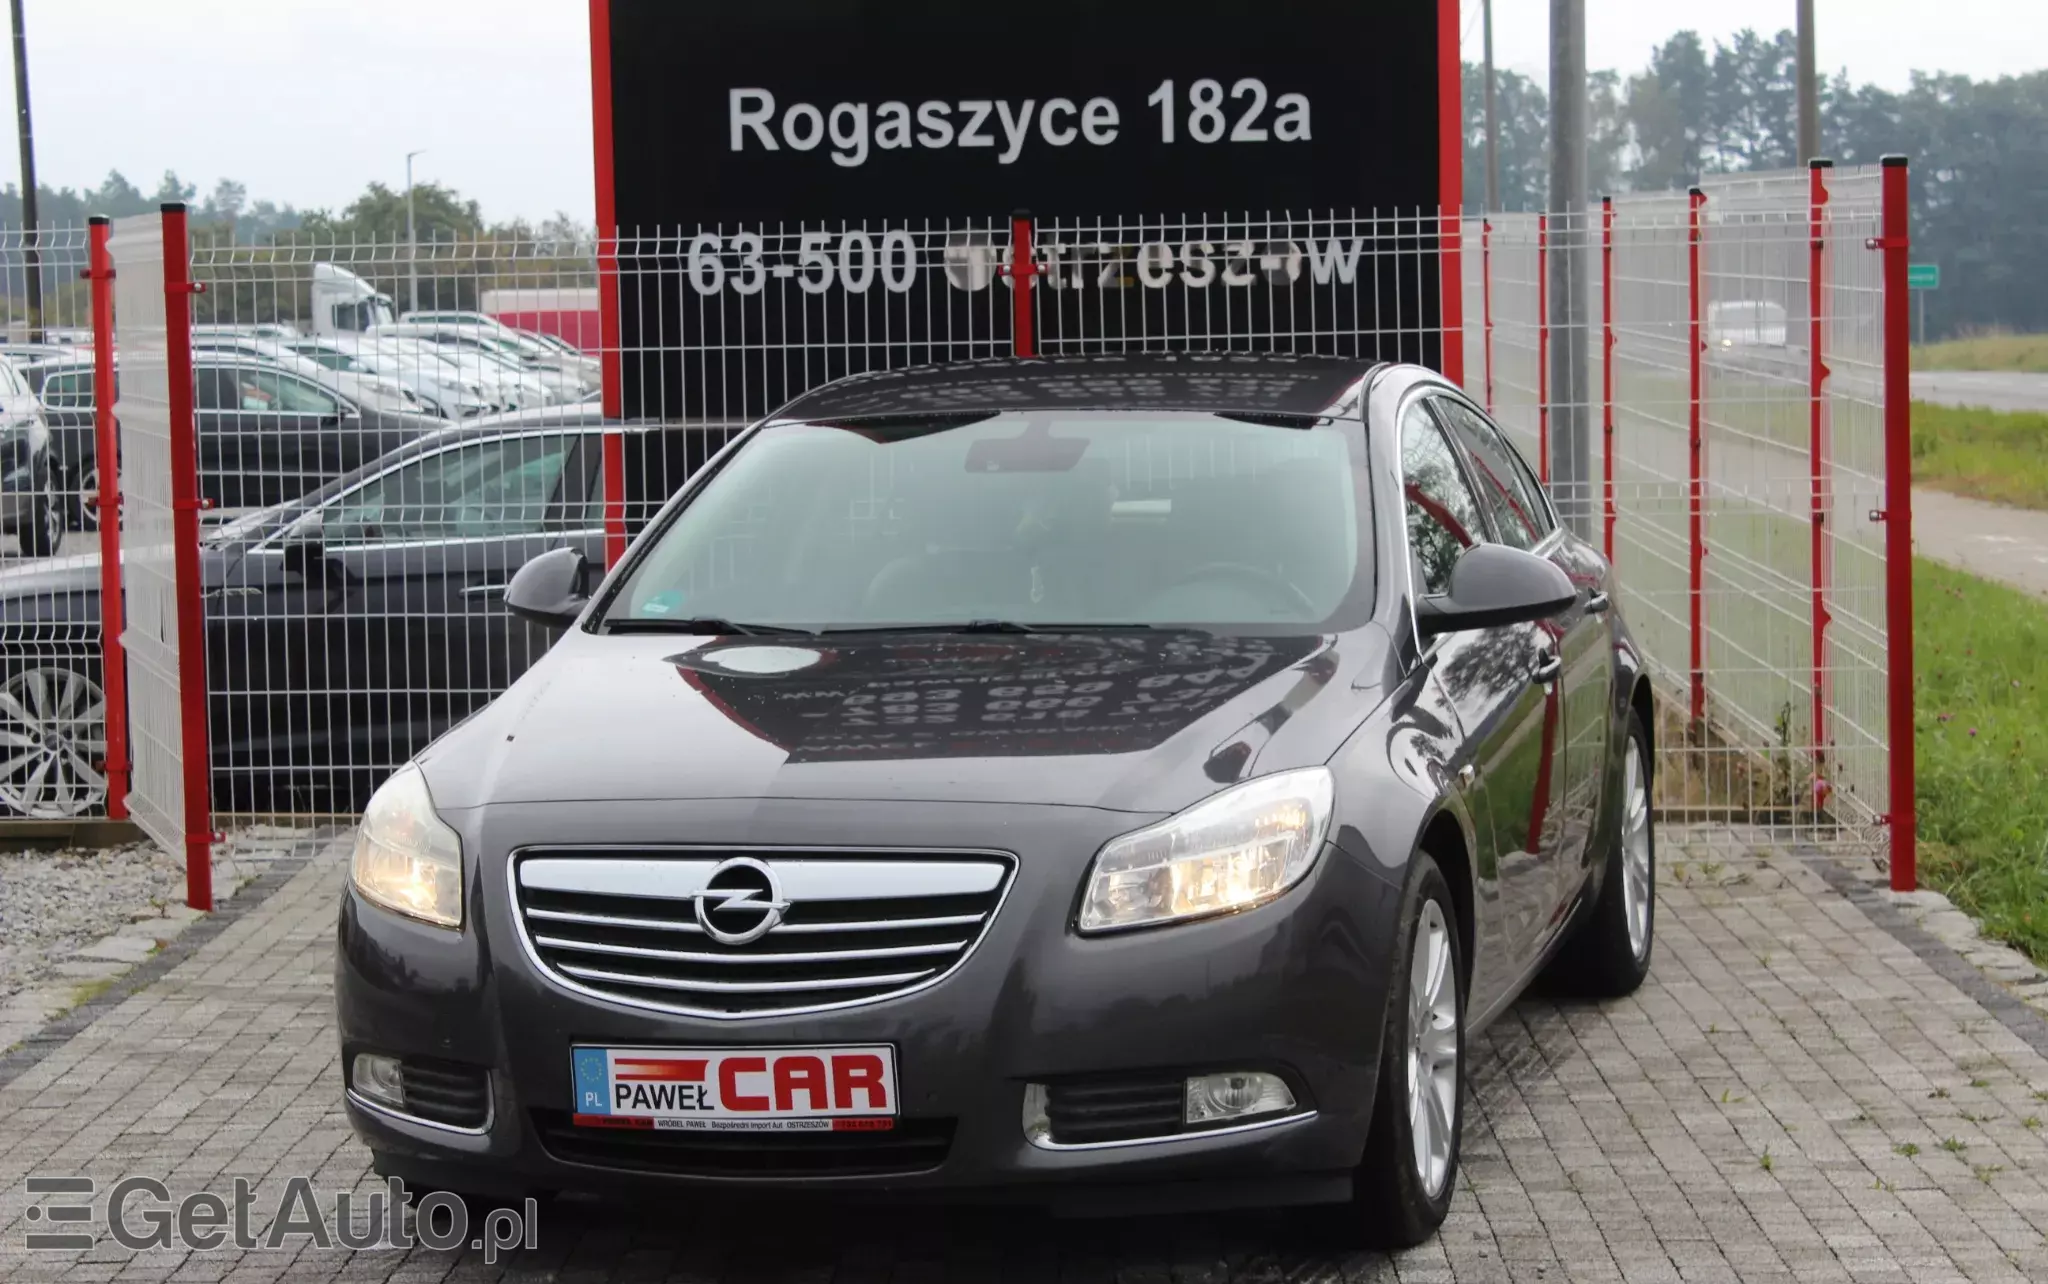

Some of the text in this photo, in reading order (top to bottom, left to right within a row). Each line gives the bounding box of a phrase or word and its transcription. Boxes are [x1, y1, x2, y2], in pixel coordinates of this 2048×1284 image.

[728, 78, 1312, 167] Rogaszyce 182a
[688, 230, 917, 296] 63-500
[585, 1092, 602, 1107] PL
[615, 1054, 887, 1112] PAWEŁ CAR
